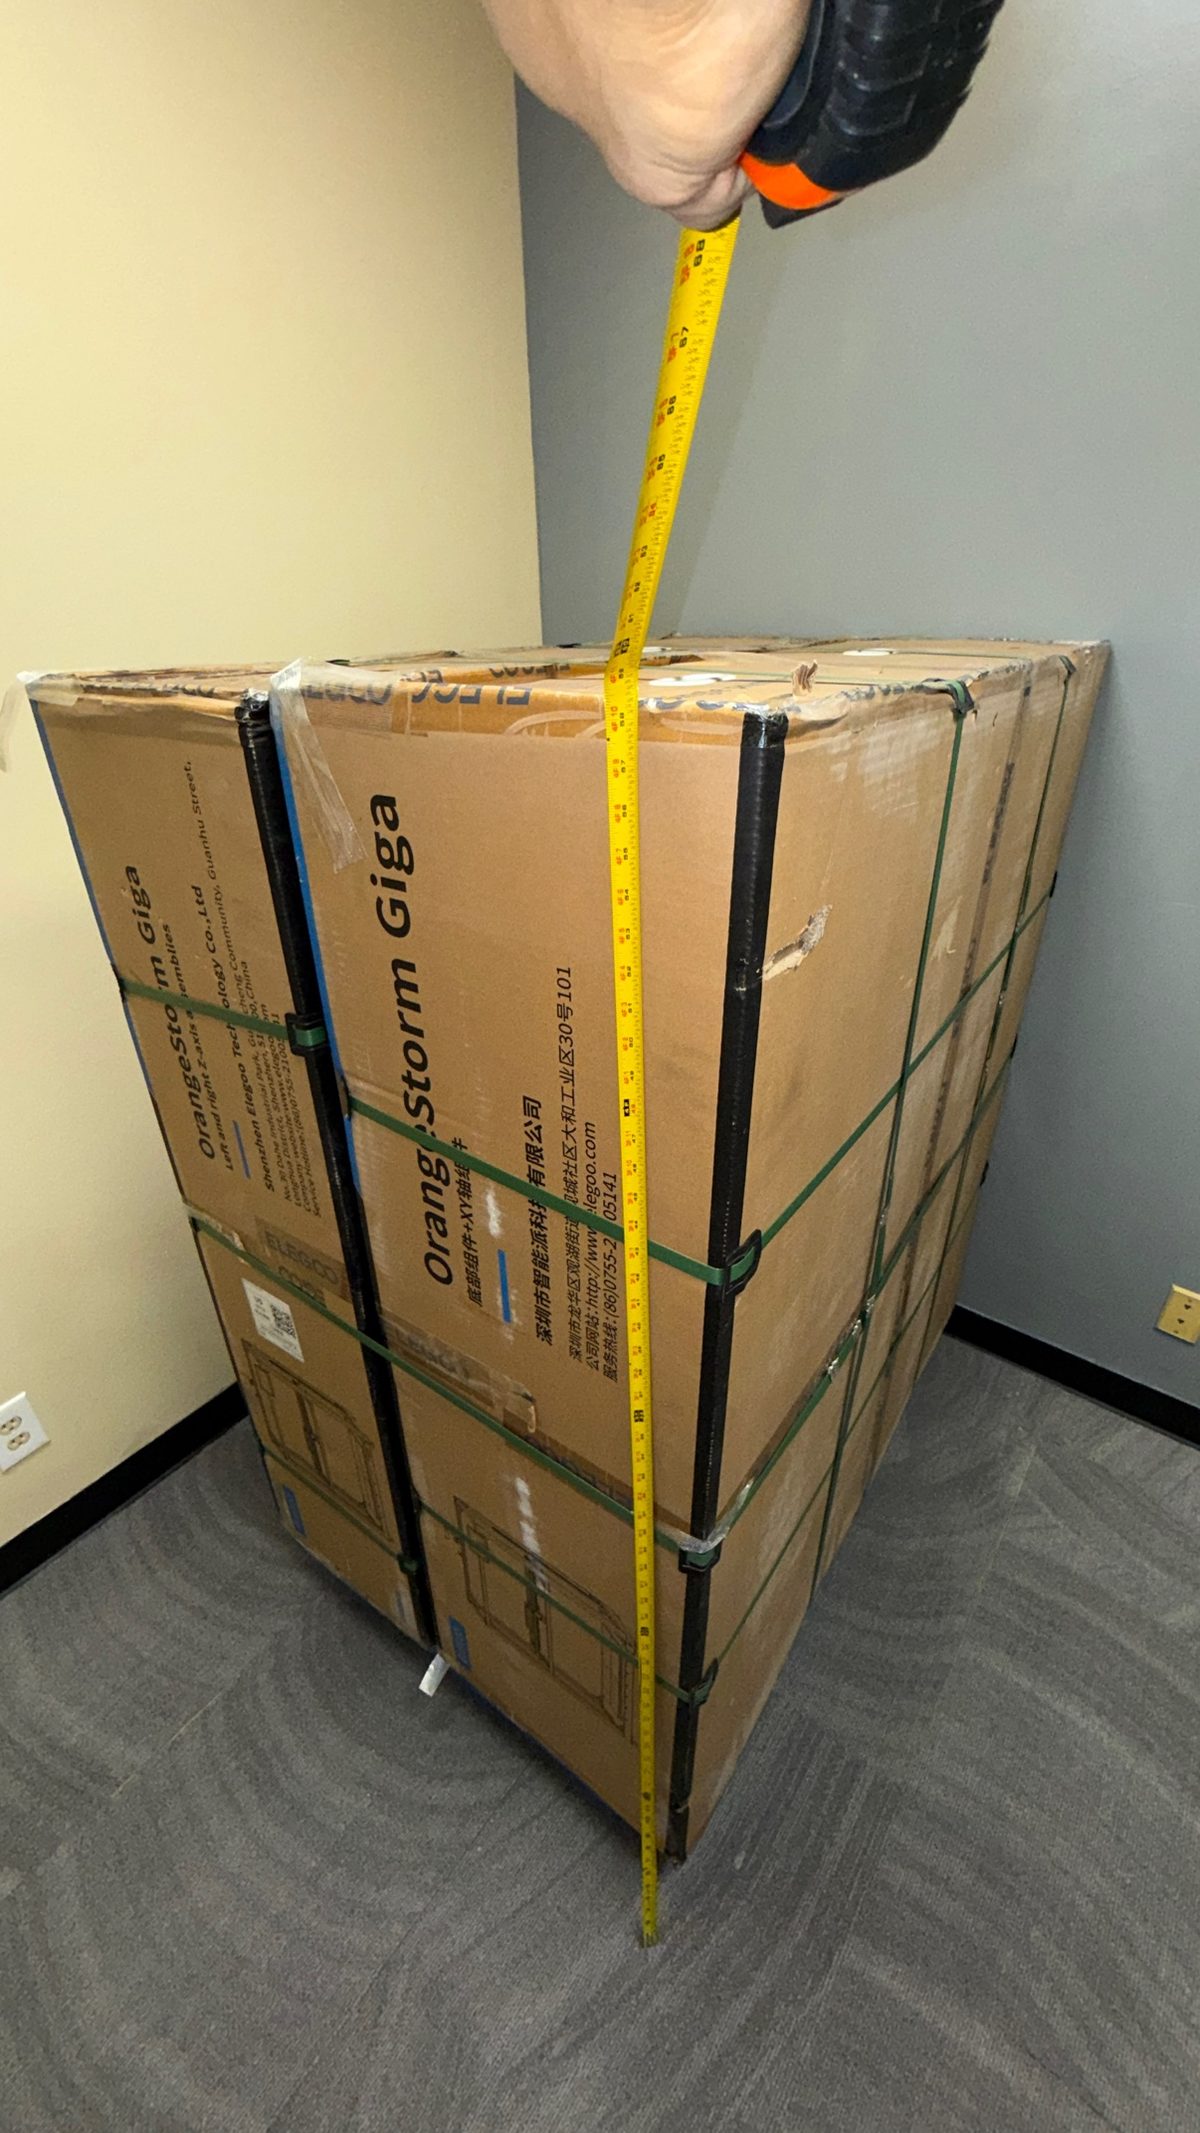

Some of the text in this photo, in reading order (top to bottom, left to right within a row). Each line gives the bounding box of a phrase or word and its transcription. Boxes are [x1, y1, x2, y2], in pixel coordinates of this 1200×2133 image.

[198, 820, 216, 879] Guanhu
[370, 794, 414, 938] Giga
[125, 866, 215, 1160] OrangeStom Giga
[163, 923, 234, 1172] Left and right Z-axis aemblies
[211, 958, 242, 1058] Tecology
[234, 974, 256, 1047] Gucheng
[238, 1063, 256, 1116] Elegoo
[252, 1120, 275, 1193] Shenzhen
[585, 1122, 602, 1372] 公司网站:http://wwwlegoo.com
[602, 1173, 619, 1383] 服务热线:(86)0755-205141
